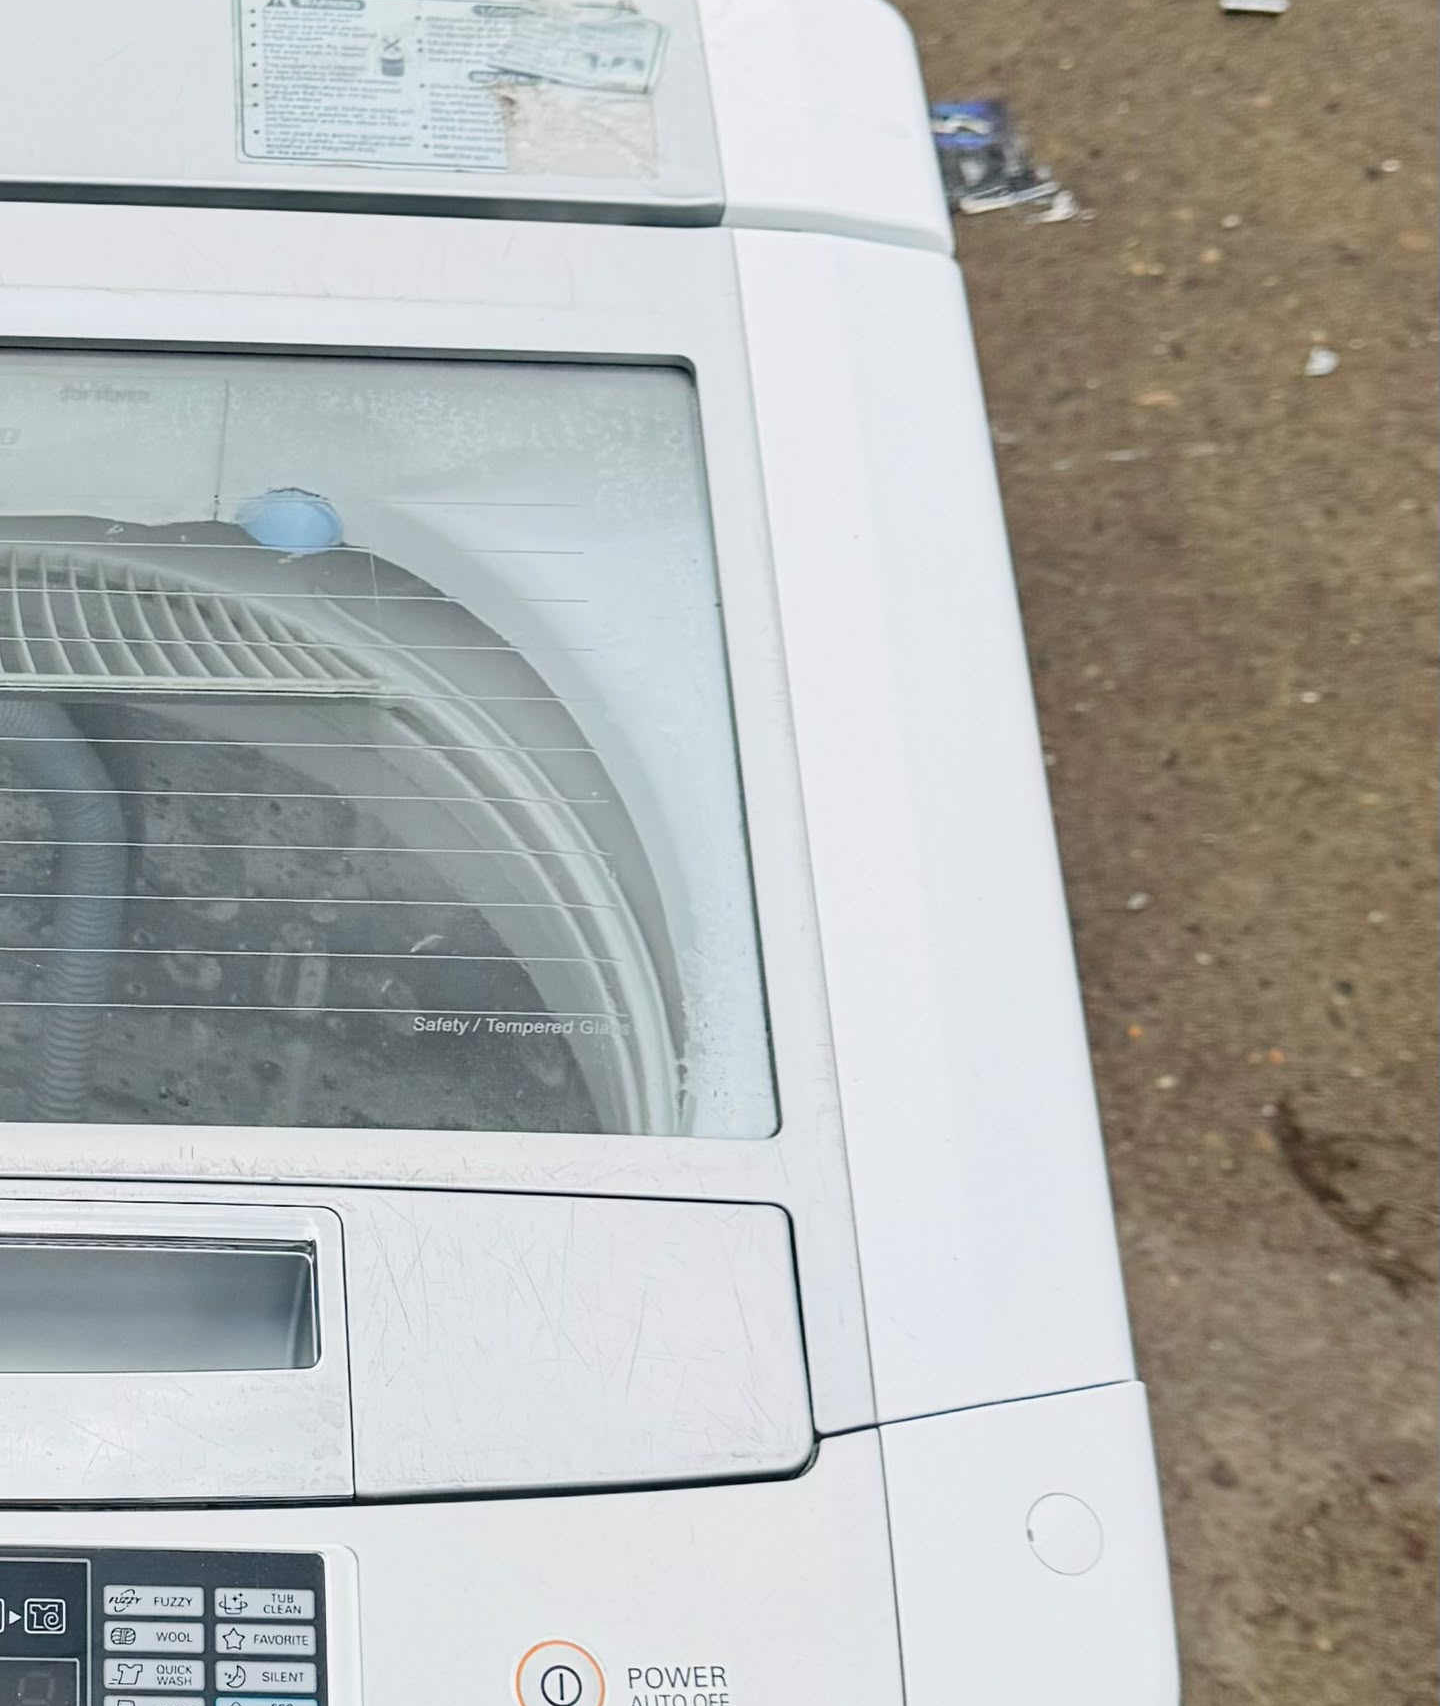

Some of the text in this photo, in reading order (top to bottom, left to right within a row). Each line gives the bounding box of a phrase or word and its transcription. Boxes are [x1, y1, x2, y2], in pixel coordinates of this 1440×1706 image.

[413, 1016, 469, 1036] Safety
[486, 1018, 573, 1036] Tempered
[154, 1596, 193, 1608] FUZZY
[271, 1593, 295, 1603] TUB
[263, 1605, 302, 1615] CLEAN
[156, 1632, 193, 1643] WOOL
[254, 1634, 309, 1646] FAVORITE
[156, 1665, 193, 1675] QUICK
[157, 1676, 193, 1686] WASH
[262, 1671, 305, 1683] SILENT
[628, 1667, 727, 1689] POWER
